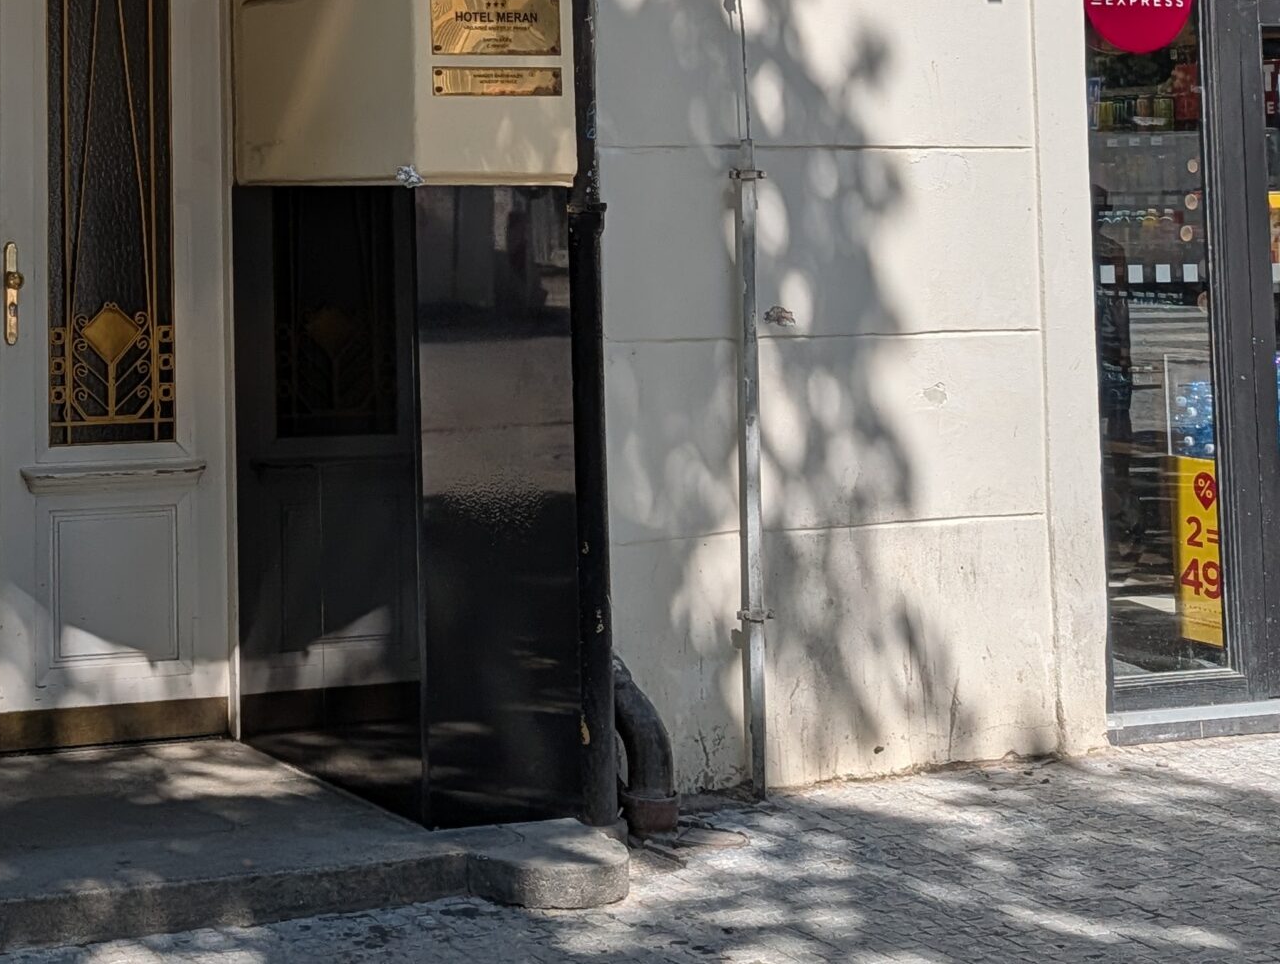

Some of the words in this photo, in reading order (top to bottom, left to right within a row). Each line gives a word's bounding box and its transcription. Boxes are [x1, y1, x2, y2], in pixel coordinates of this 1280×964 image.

[455, 11, 494, 22] HOTEL
[496, 11, 538, 23] MERAN
[1181, 558, 1222, 600] 49
